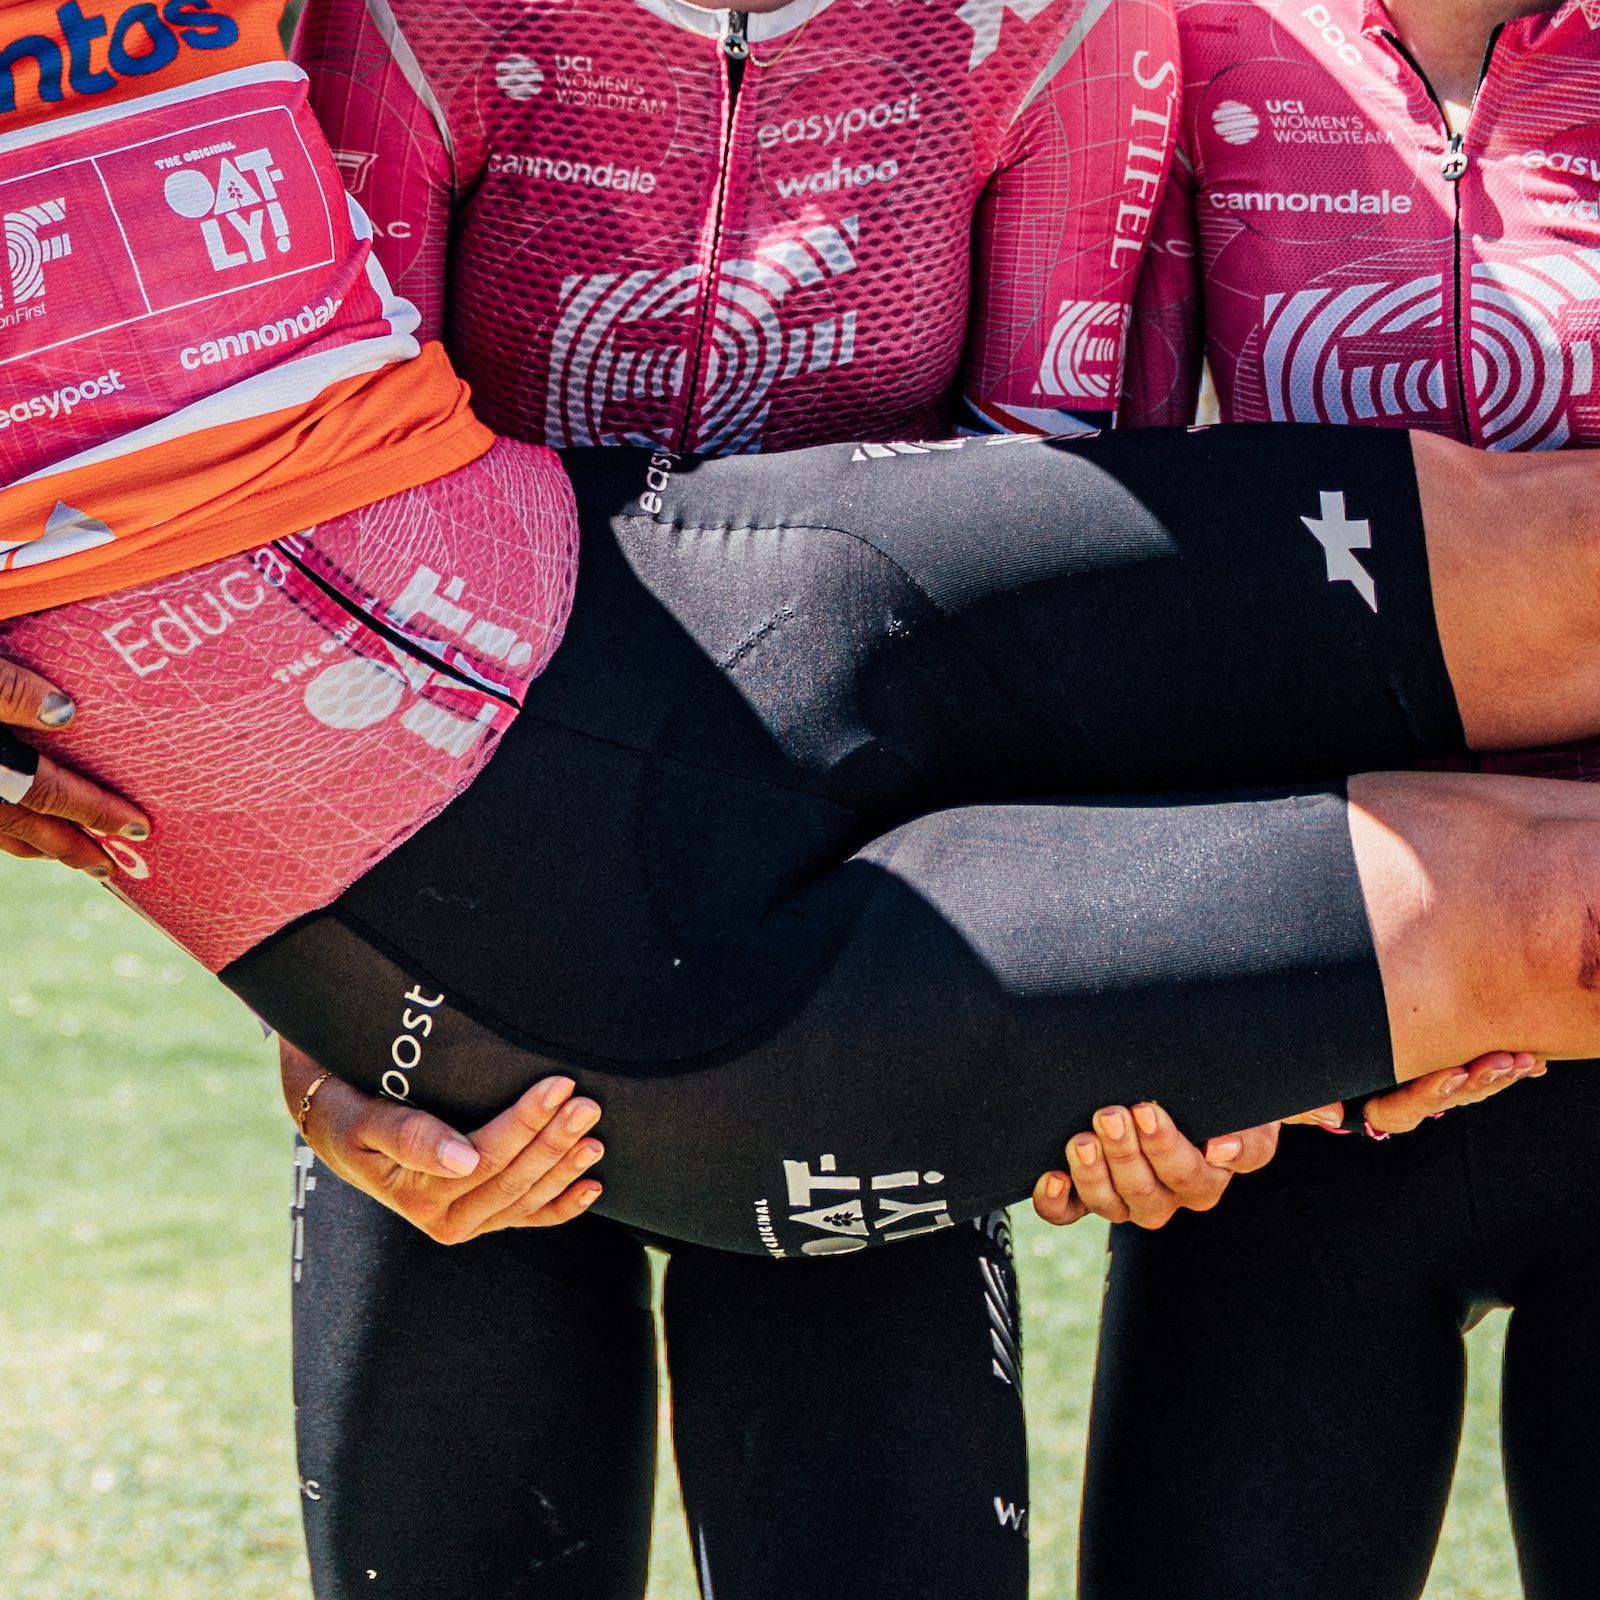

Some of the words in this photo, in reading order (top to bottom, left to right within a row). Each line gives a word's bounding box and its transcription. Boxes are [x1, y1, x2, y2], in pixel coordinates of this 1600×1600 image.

[1302, 4, 1362, 66] poc
[555, 55, 593, 71] UCI
[555, 72, 645, 94] WOMEN'S
[555, 89, 668, 114] WORLDTEAM
[1266, 100, 1304, 114] UCI
[757, 93, 922, 148] easypost
[1270, 114, 1364, 130] WOMEN'S
[1274, 130, 1395, 144] WORLDTEAM
[154, 155, 183, 170] THE
[183, 141, 237, 162] ORIGINAL
[1111, 50, 1176, 268] STIFEL
[488, 155, 656, 194] cannondale
[775, 157, 898, 198] wahoo
[1209, 190, 1412, 214] cannondale
[201, 201, 291, 272] LY!
[15, 301, 47, 328] First
[271, 652, 322, 683] THE
[380, 984, 445, 1106] post
